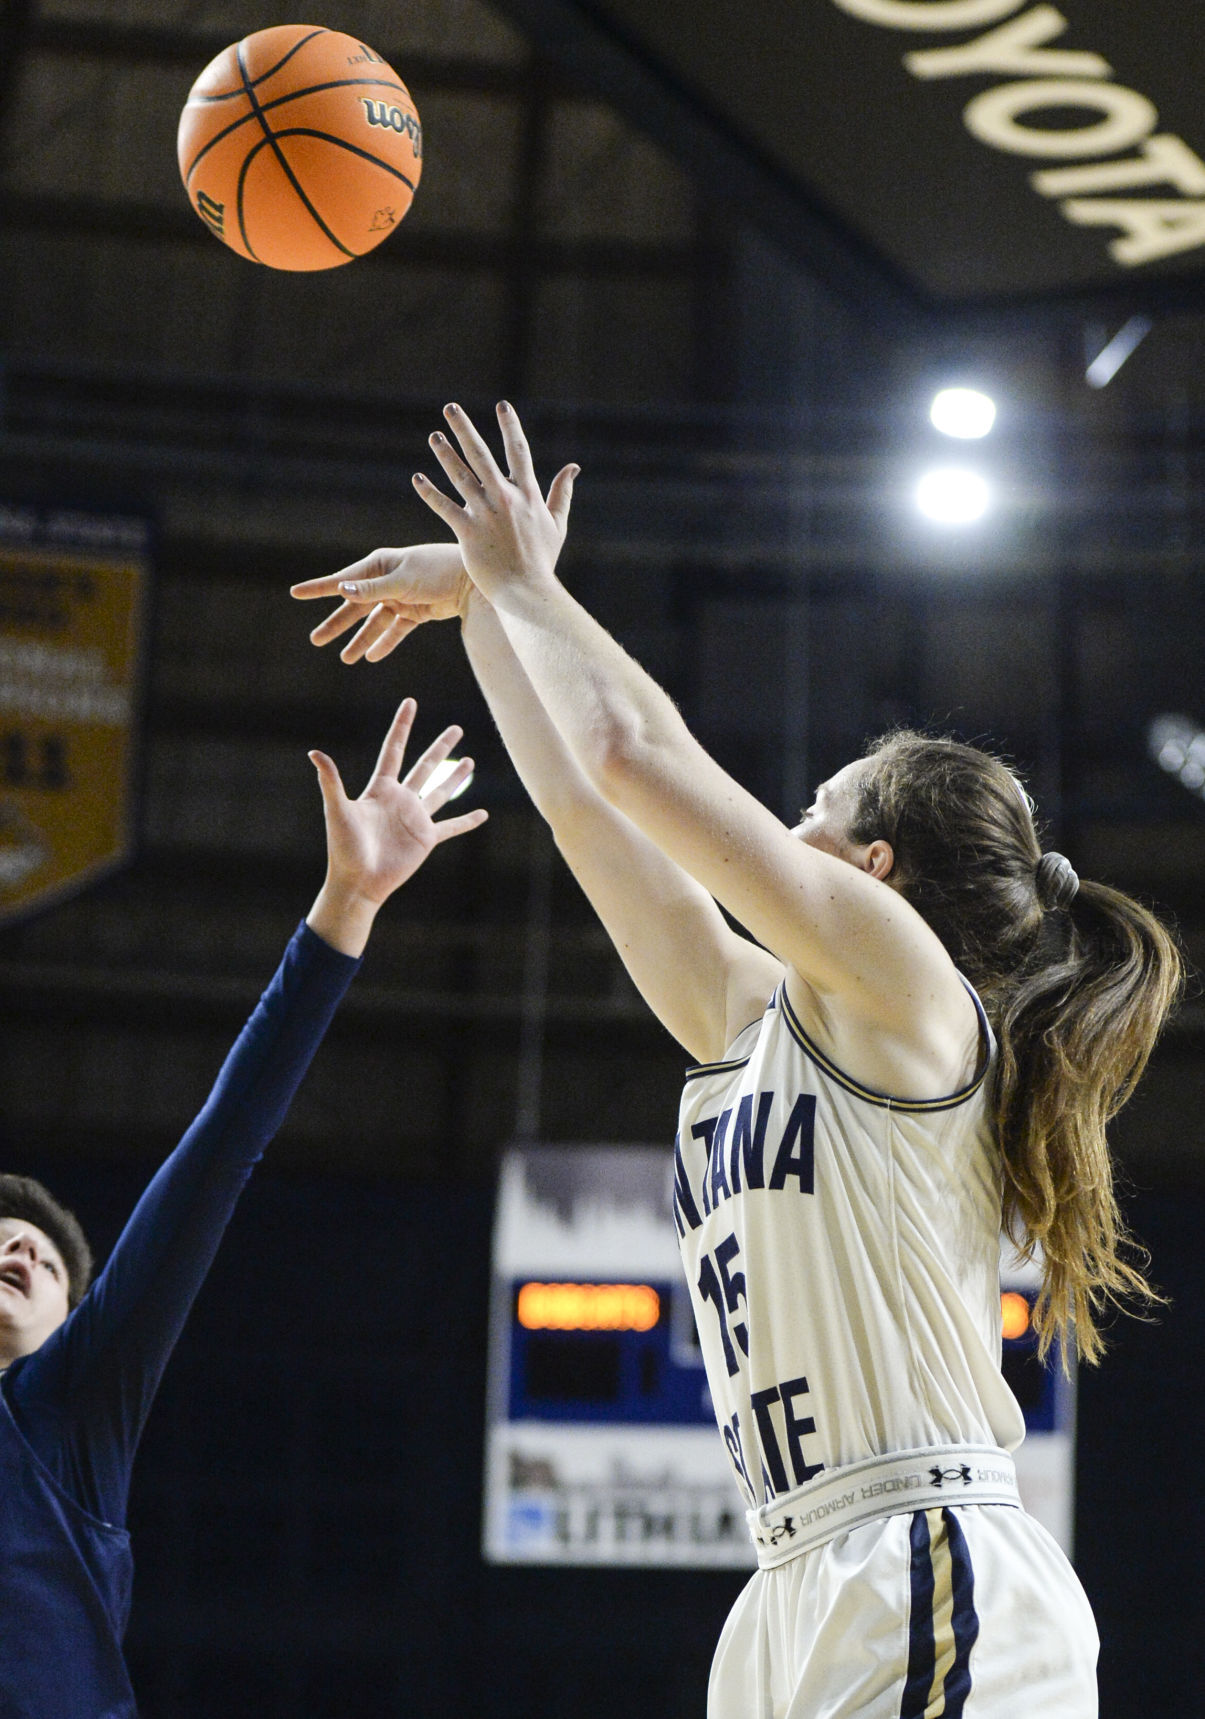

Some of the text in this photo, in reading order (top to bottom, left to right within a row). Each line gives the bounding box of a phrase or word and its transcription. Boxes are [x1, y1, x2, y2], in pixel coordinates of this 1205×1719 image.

[673, 1091, 817, 1239] NTANA
[697, 1232, 749, 1377] 15
[799, 1475, 921, 1526] UNDER ARMOUR
